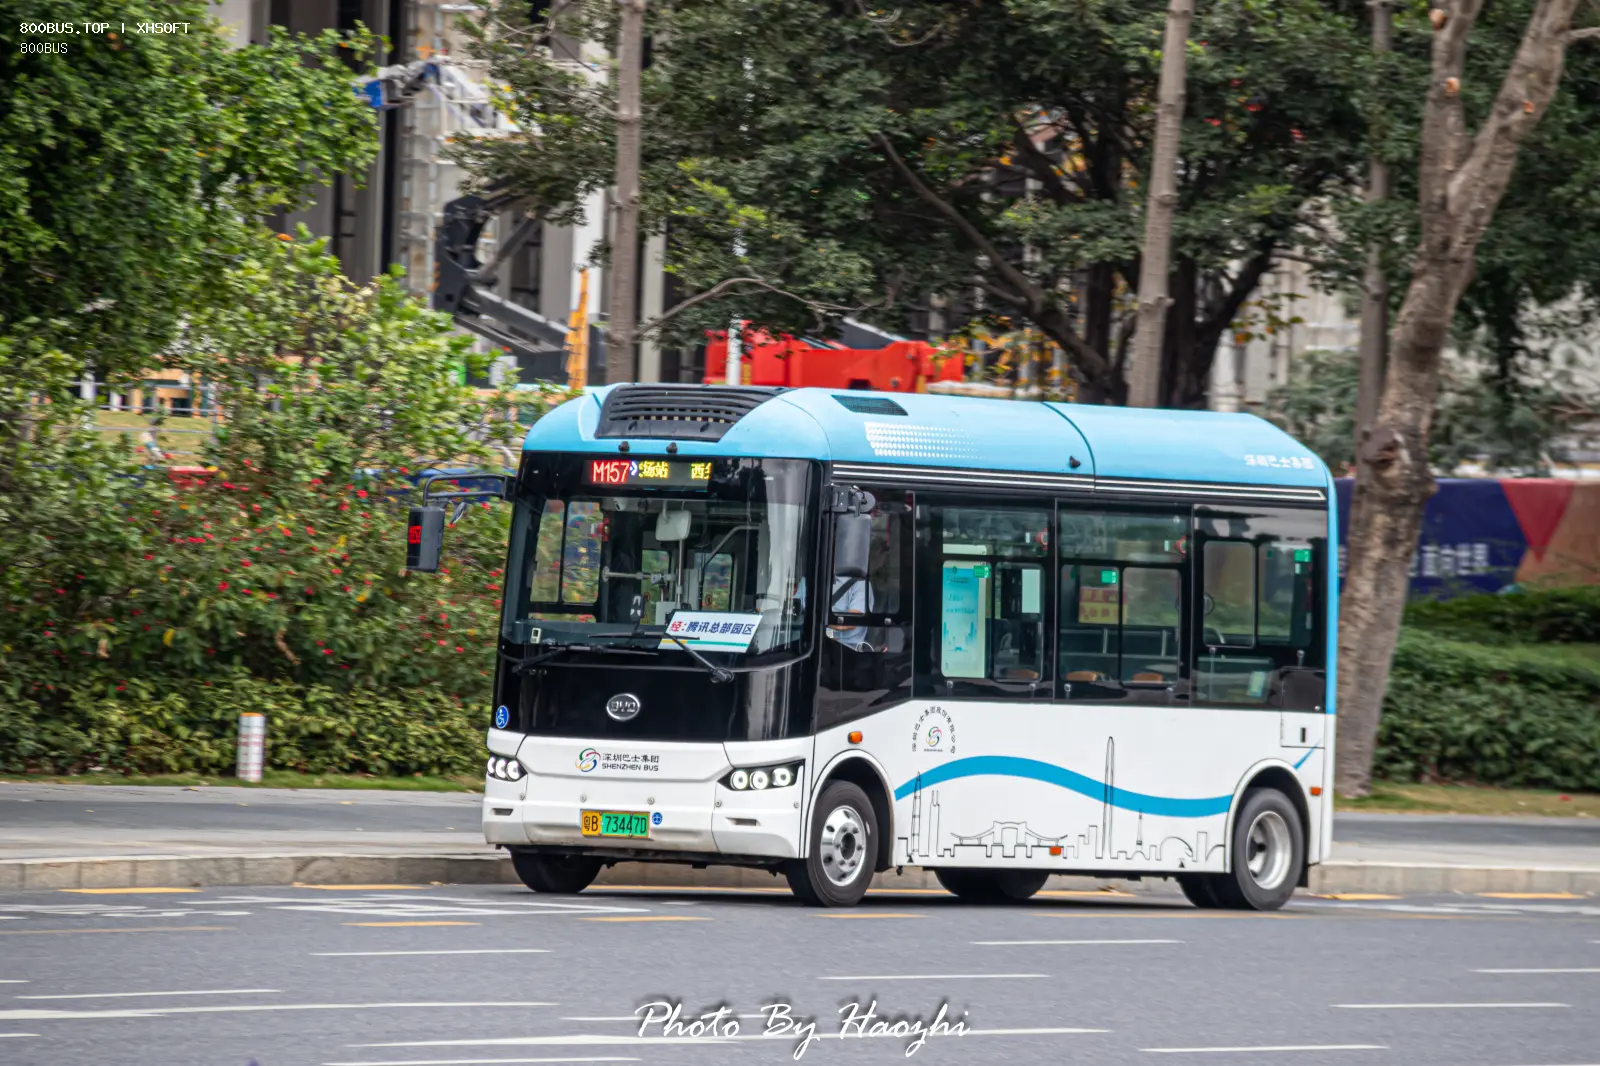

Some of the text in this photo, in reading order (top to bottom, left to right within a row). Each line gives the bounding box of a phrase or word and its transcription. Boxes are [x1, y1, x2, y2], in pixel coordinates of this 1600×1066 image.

[592, 460, 630, 483] M157
[610, 700, 636, 713] BYD
[602, 753, 660, 764] 深圳巴士集团
[601, 763, 659, 772] SHENZHEN BUS
